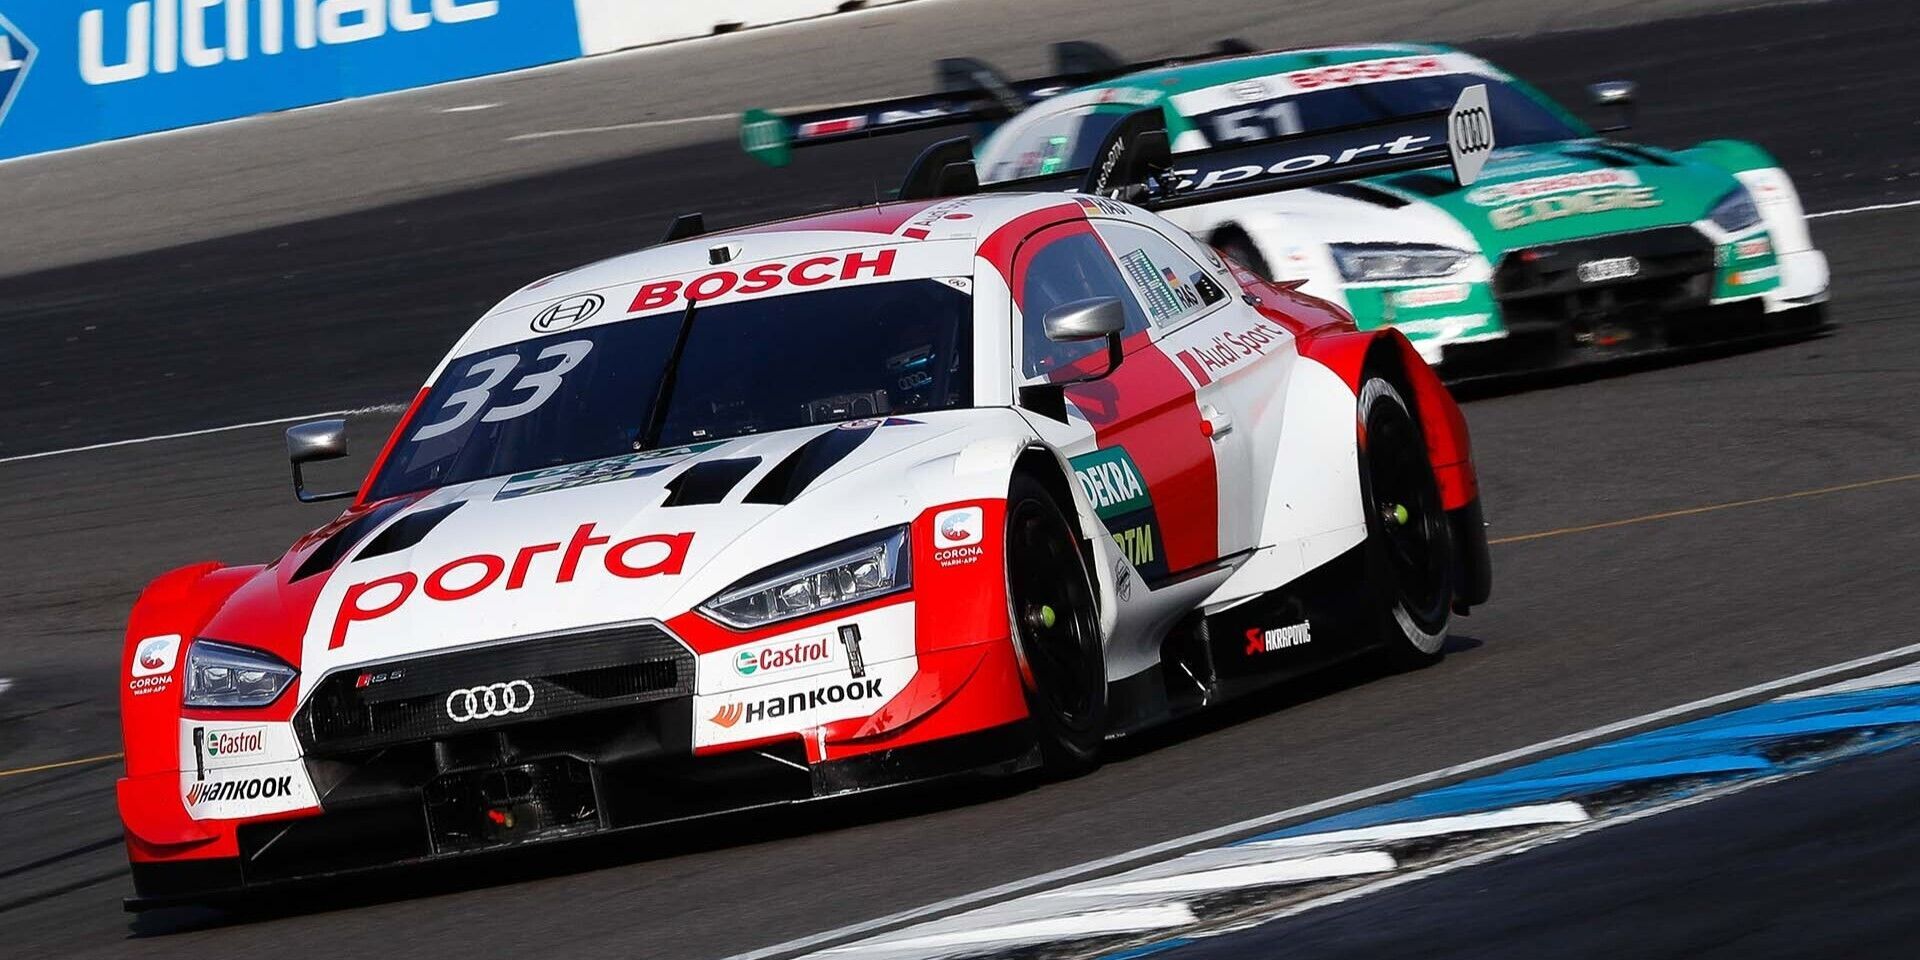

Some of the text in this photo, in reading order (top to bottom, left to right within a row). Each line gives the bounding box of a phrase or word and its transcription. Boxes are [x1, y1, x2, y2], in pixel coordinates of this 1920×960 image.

[627, 249, 898, 313] BOSCH
[1192, 323, 1283, 372] Audi Sport
[411, 340, 594, 442] 33
[1075, 457, 1143, 510] DEKRA
[934, 546, 984, 561] CORONA
[328, 522, 696, 650] porta
[759, 638, 829, 670] Castrol
[129, 675, 173, 690] CORONA
[219, 730, 263, 755] Castrol
